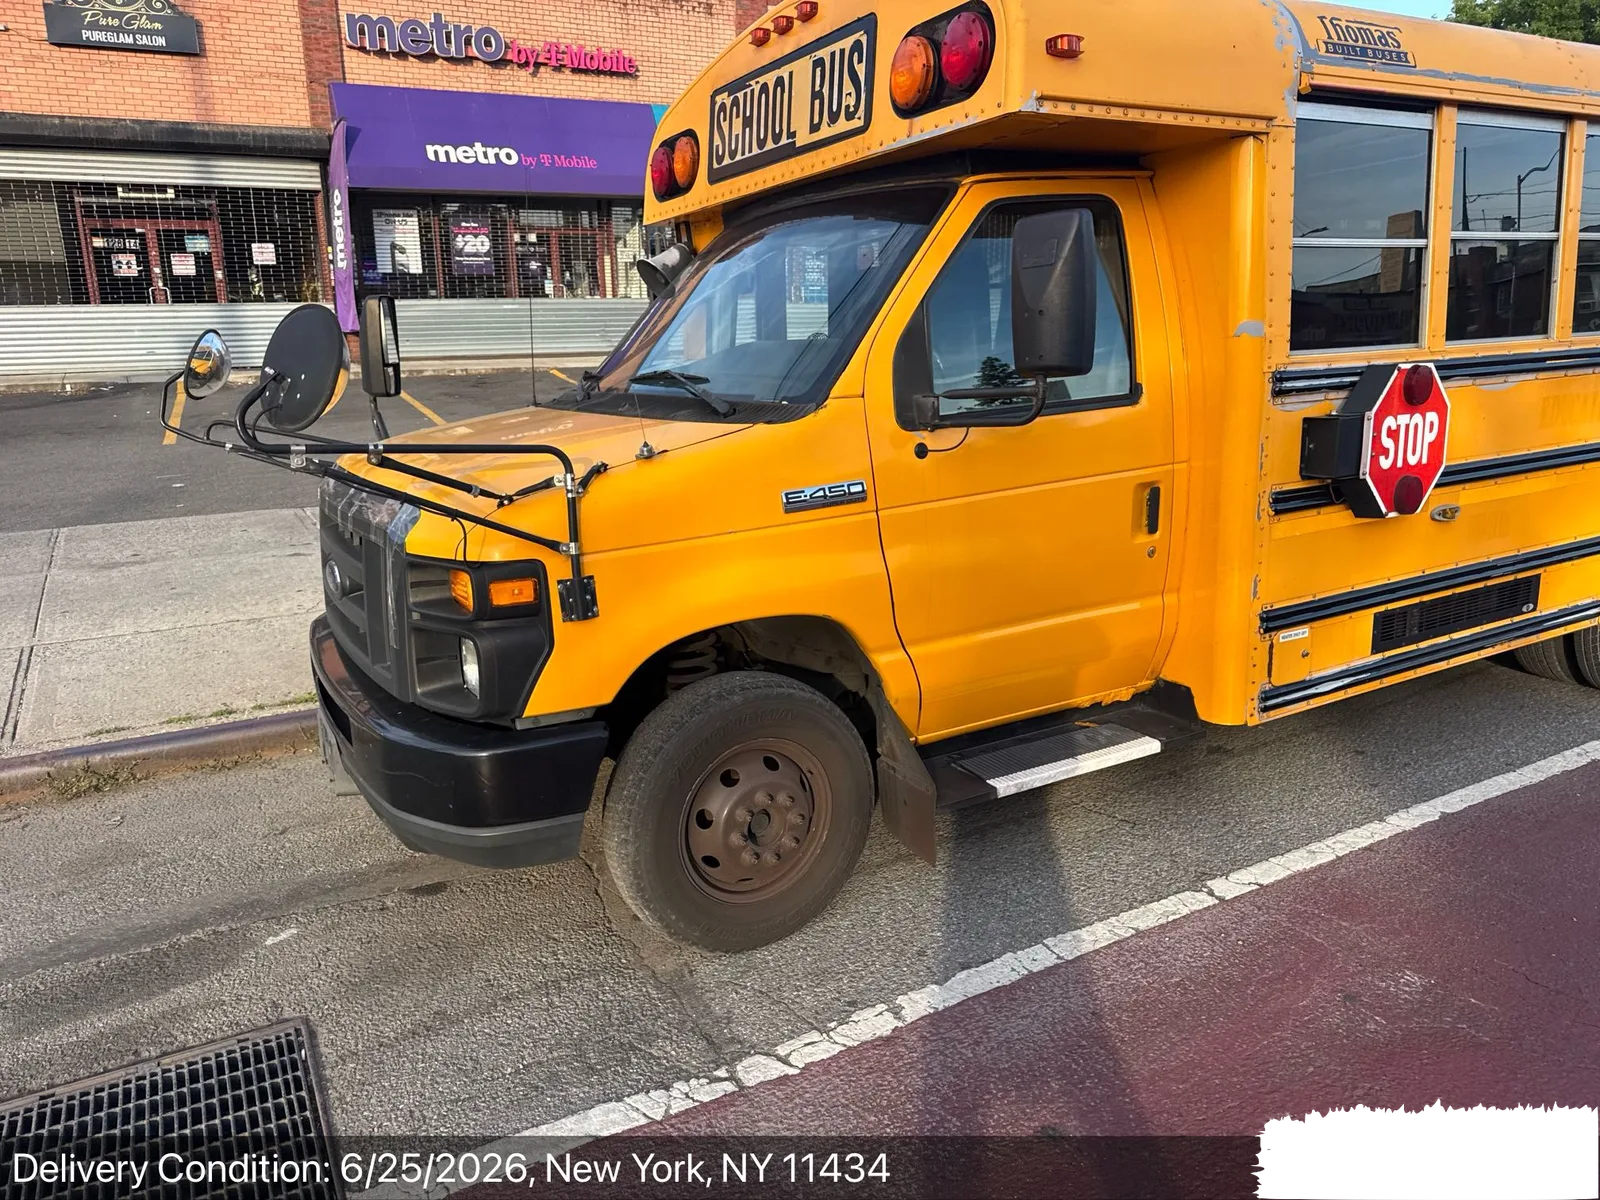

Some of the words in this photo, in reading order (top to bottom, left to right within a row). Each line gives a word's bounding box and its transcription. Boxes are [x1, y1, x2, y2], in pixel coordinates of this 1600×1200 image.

[81, 10, 119, 26] Pure
[122, 13, 163, 29] Glam
[1317, 15, 1403, 50] Thomas
[81, 29, 134, 45] PUREGLAM
[135, 34, 167, 47] SALON
[344, 11, 506, 62] metro
[510, 39, 538, 72] by
[1327, 43, 1362, 56] BUILT
[1367, 48, 1407, 62] BUSES
[714, 69, 797, 166] SCHOOL
[808, 38, 866, 135] BUS
[425, 141, 520, 166] metro
[520, 153, 538, 169] by
[333, 188, 348, 271] metro
[1379, 412, 1439, 470] STOP
